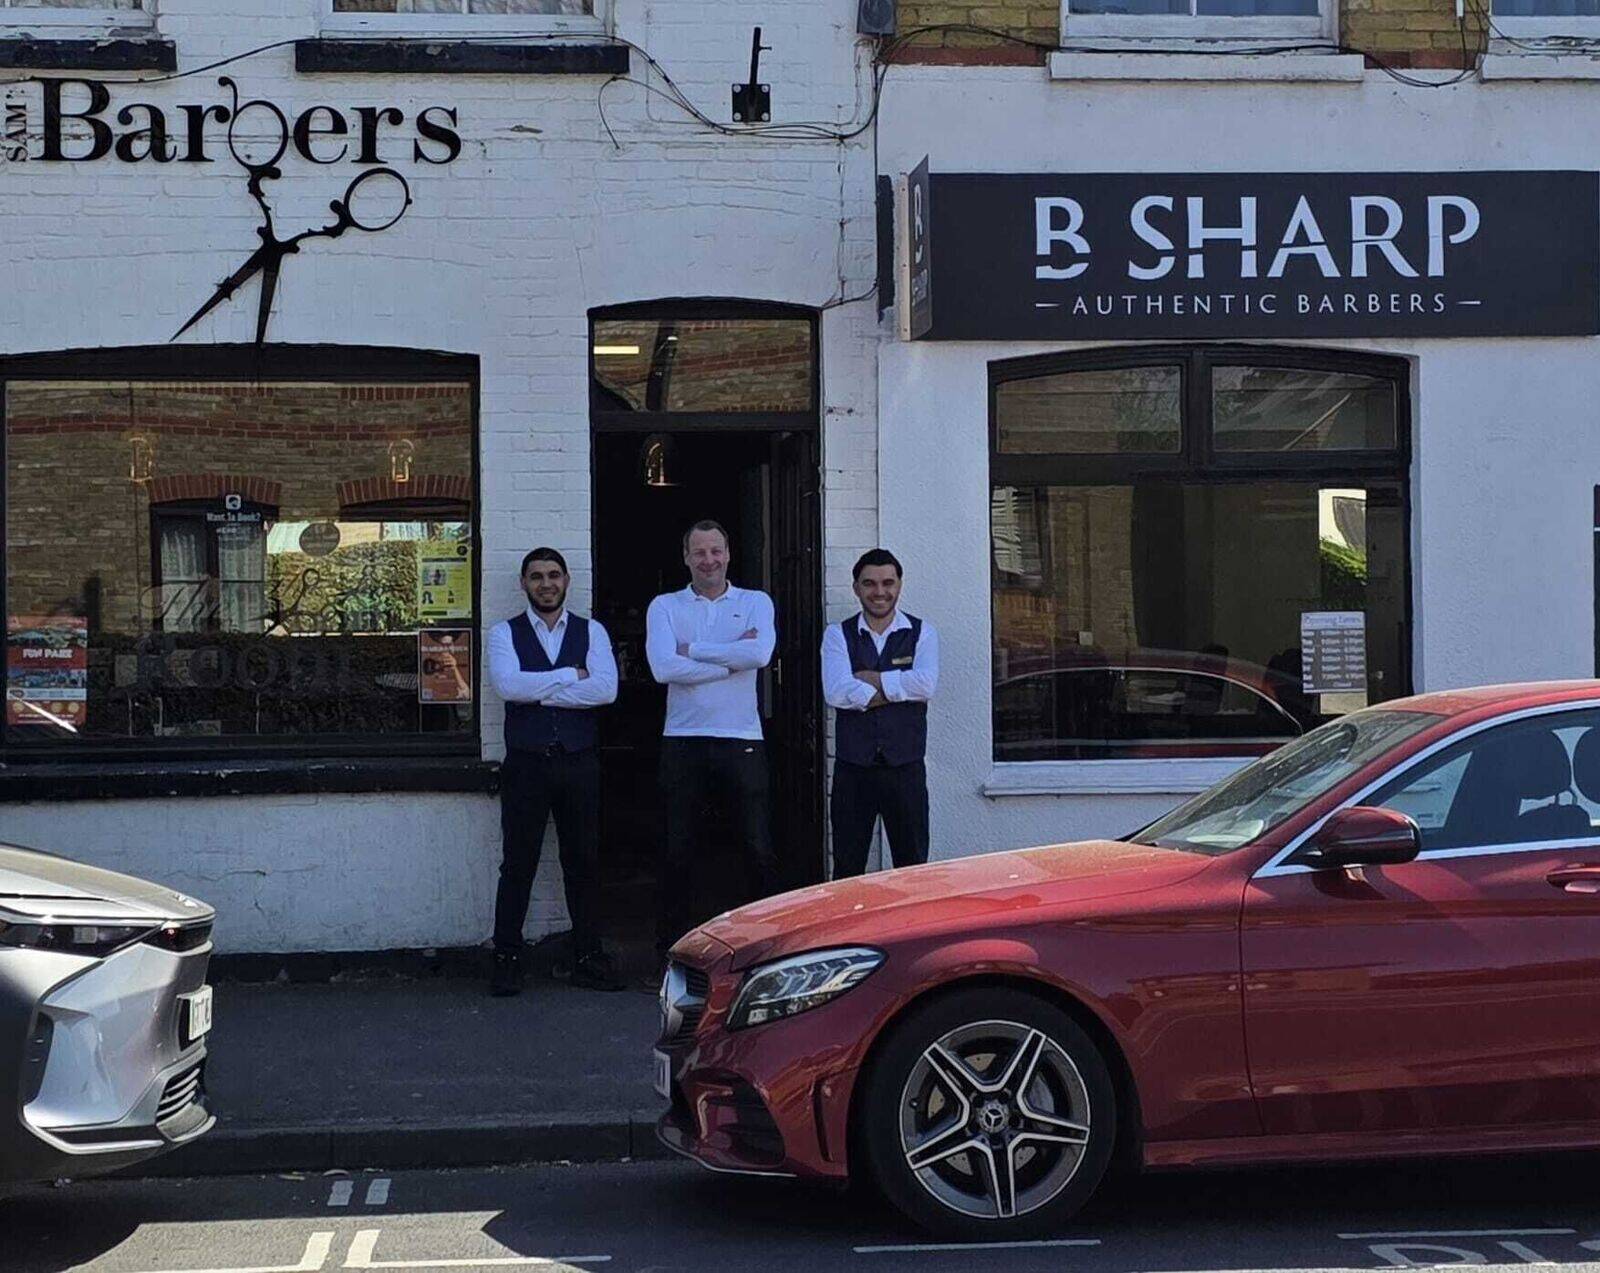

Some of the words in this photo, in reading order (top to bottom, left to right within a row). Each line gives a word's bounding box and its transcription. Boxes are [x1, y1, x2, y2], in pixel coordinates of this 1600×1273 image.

[31, 76, 463, 165] Barbers
[1035, 196, 1091, 280] B
[1128, 194, 1481, 280] SHARP
[1072, 294, 1277, 315] AUTHENTIC
[1297, 293, 1446, 314] BARBERS
